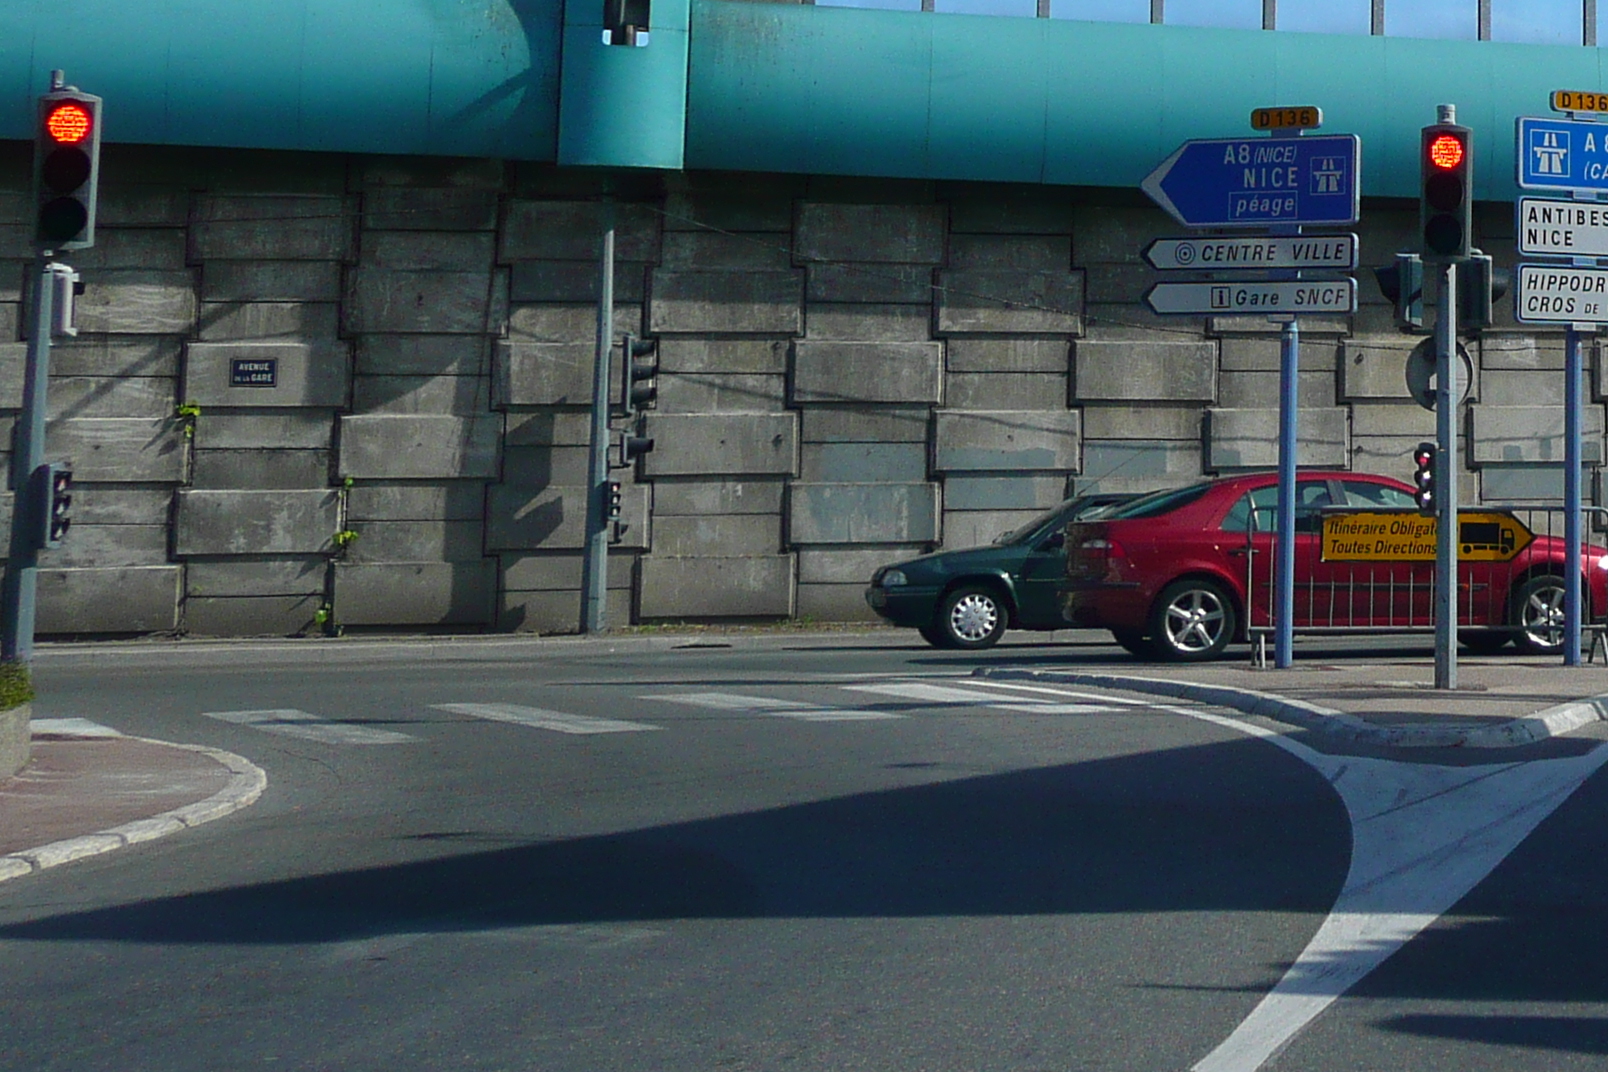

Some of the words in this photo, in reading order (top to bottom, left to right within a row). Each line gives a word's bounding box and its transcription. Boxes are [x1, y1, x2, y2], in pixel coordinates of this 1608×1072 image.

[1224, 145, 1250, 164] A8
[1254, 145, 1297, 164] (NICE)
[1244, 168, 1298, 188] NICE
[1236, 195, 1294, 216] péage
[1528, 230, 1573, 246] NICE
[1202, 245, 1276, 262] CENTRE
[1292, 244, 1344, 260] VILLE
[1236, 288, 1279, 305] Gare
[1295, 288, 1345, 305] SNCF
[1528, 296, 1575, 313] CROS
[1584, 303, 1598, 314] DE
[239, 363, 269, 371] AVENUE
[251, 374, 272, 382] GARE
[1329, 521, 1386, 535] Itinéraire
[1331, 540, 1371, 554] Toutes
[1375, 540, 1437, 554] Directions
